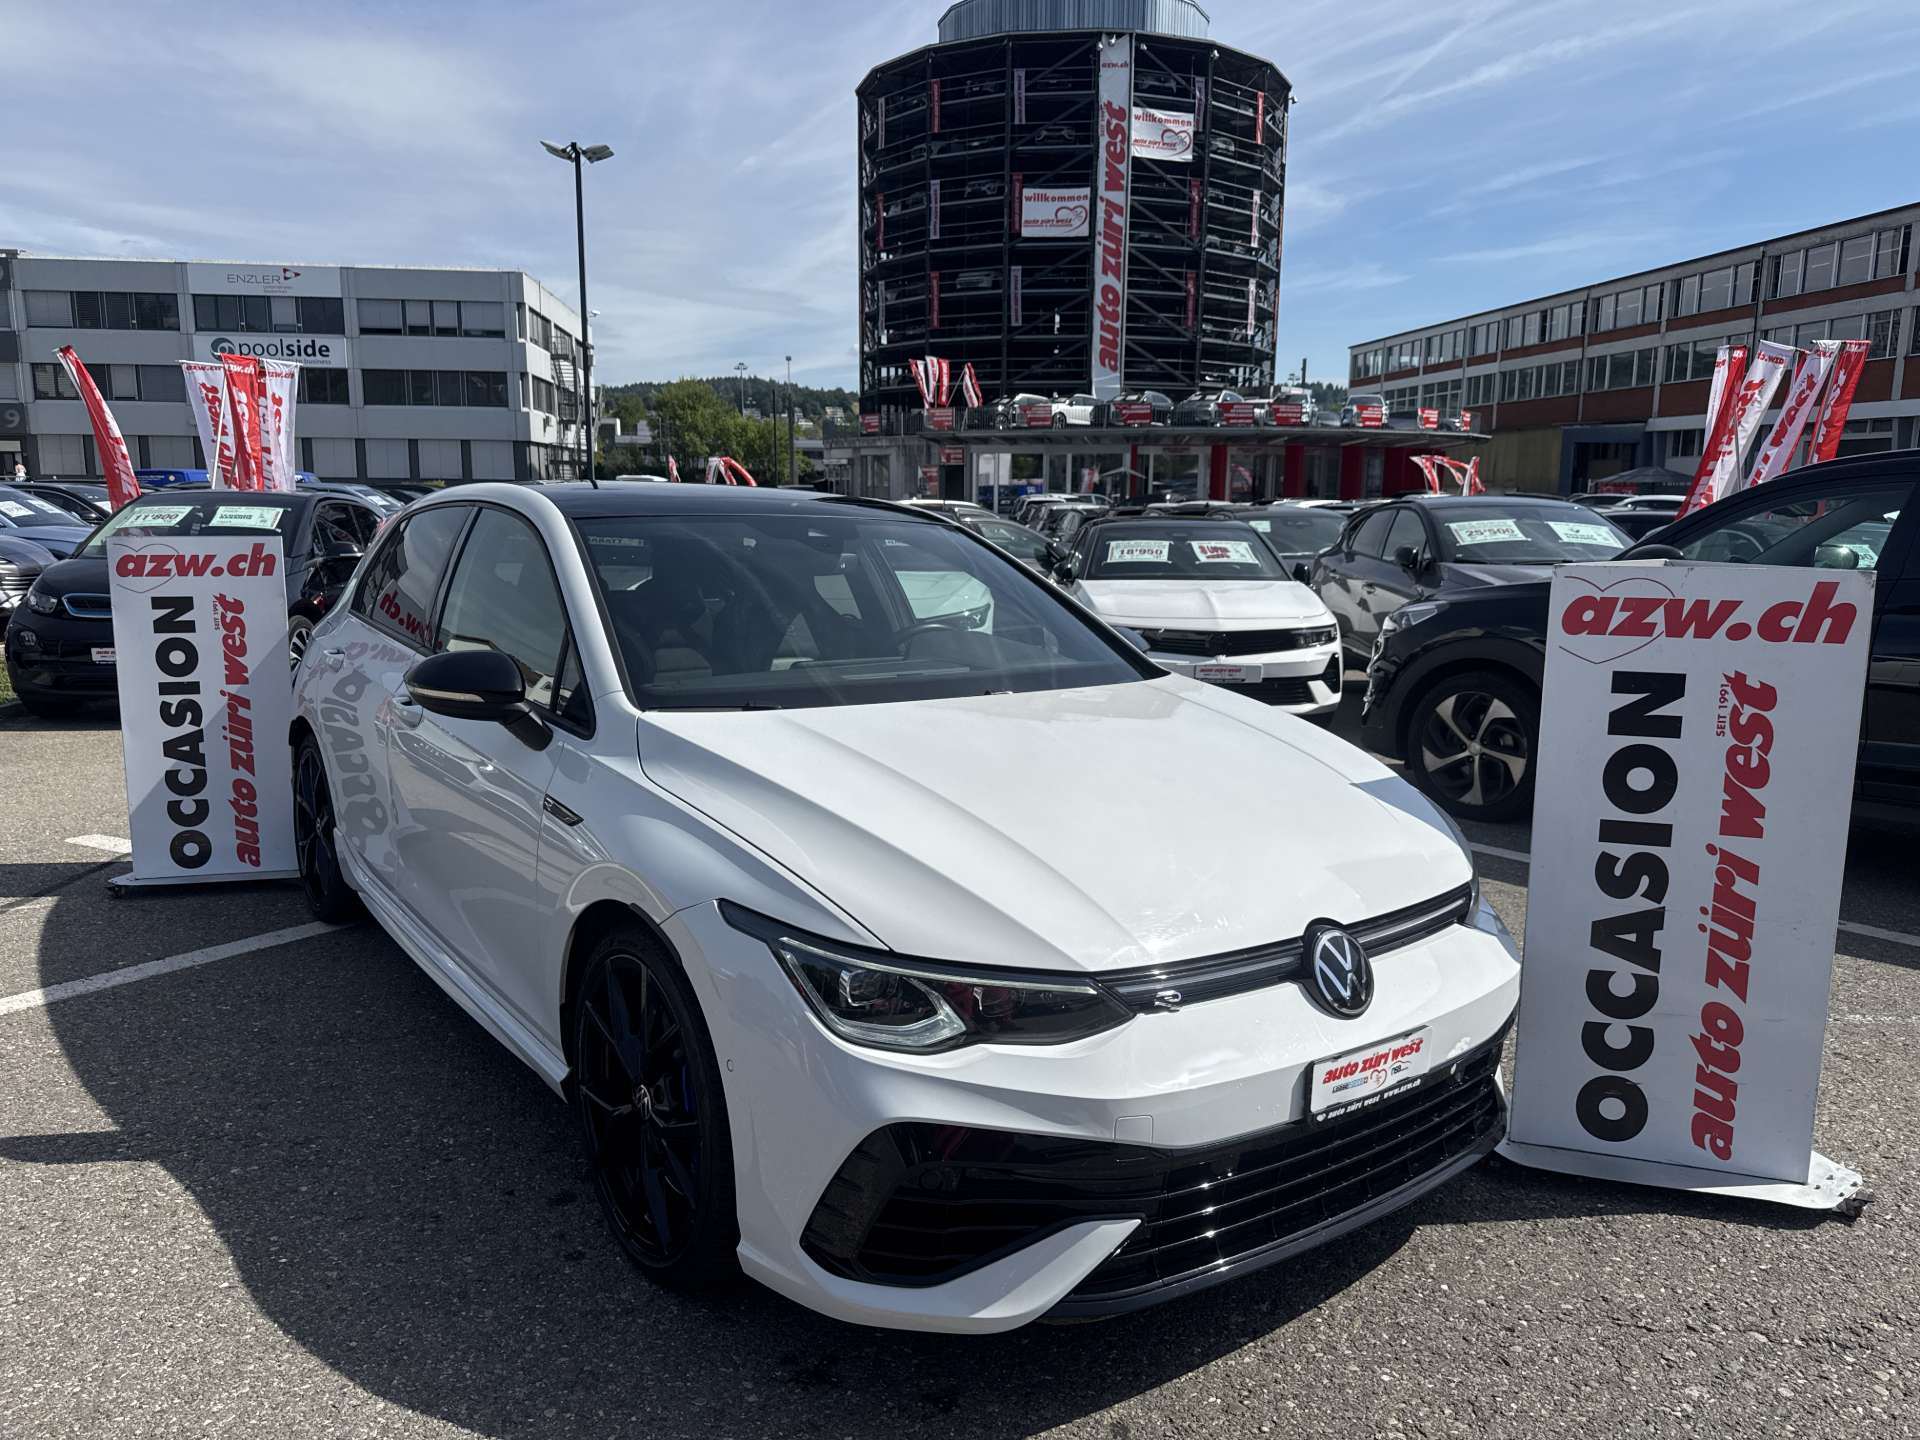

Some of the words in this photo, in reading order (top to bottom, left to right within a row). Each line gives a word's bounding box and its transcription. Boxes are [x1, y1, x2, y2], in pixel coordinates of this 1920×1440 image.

[1104, 100, 1127, 192] west
[1134, 112, 1192, 127] willkommen
[1024, 193, 1089, 203] willkommen
[1096, 195, 1124, 283] züri
[227, 273, 280, 284] ENZLER
[239, 338, 330, 358] poolside
[1097, 284, 1121, 373] auto
[116, 543, 277, 577] azw.ch
[212, 592, 250, 685] west
[1561, 581, 1858, 644] azw.ch
[151, 596, 212, 869] OCCASION
[219, 689, 256, 777] züri
[1716, 713, 1728, 737] SEIT
[1718, 683, 1730, 710] 1991
[1719, 670, 1777, 839] west
[226, 778, 261, 867] auto
[1575, 670, 1687, 1142] OCCASION
[1697, 843, 1761, 1005] züri
[1323, 1061, 1359, 1084] auto
[1359, 1048, 1391, 1074] züri
[1391, 1038, 1424, 1062] west
[1688, 1002, 1745, 1161] auto
[1327, 1107, 1346, 1120] auto
[1364, 1094, 1380, 1108] west
